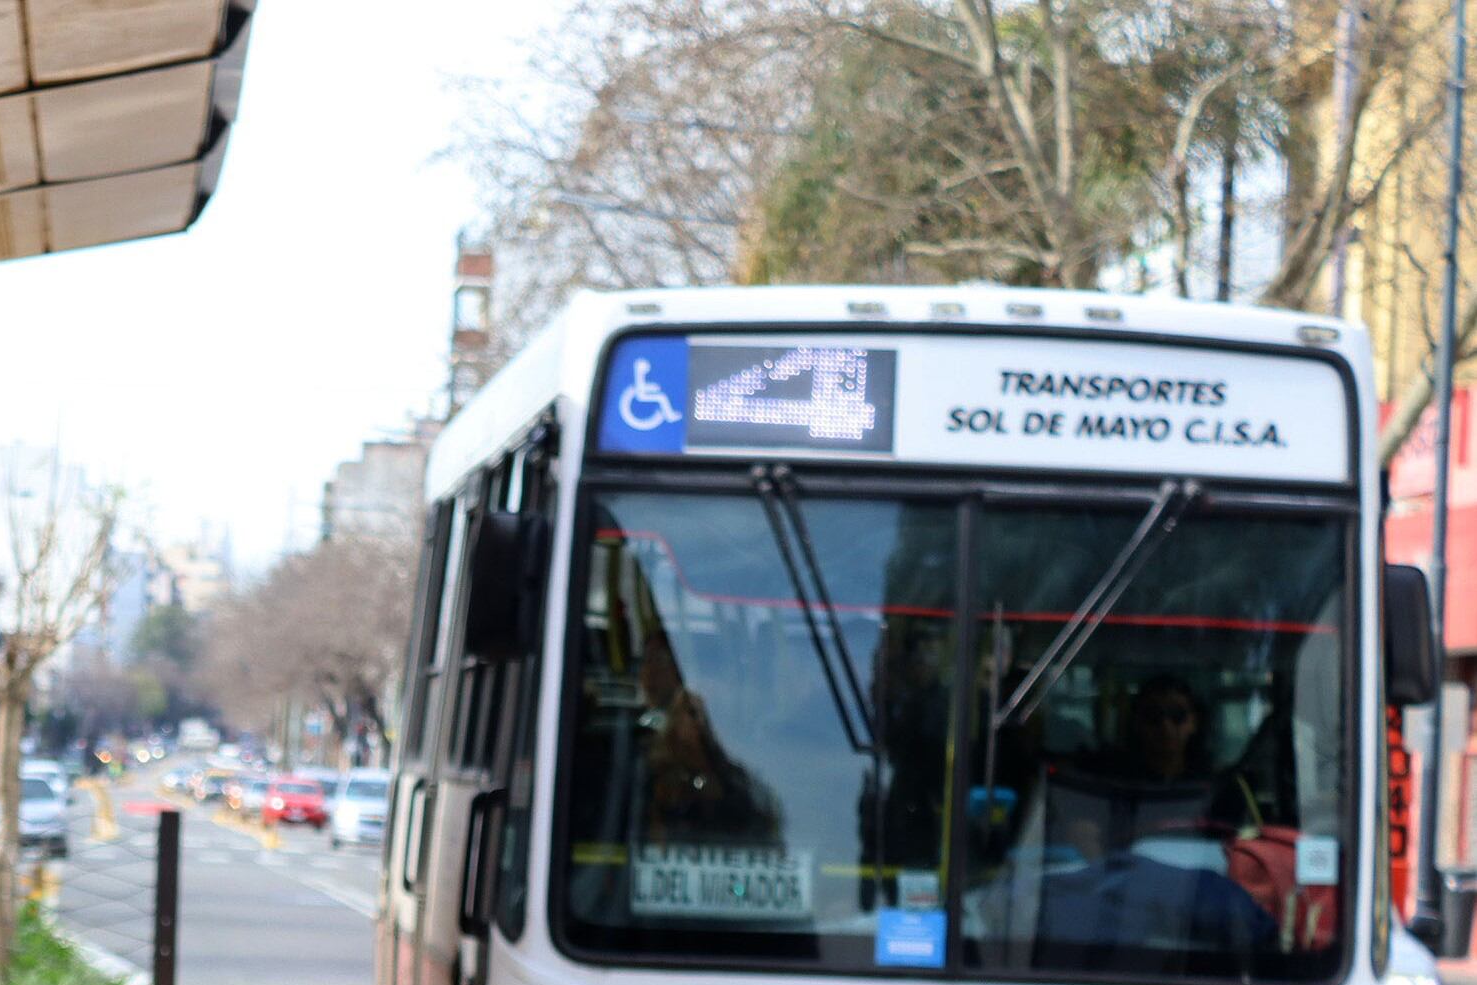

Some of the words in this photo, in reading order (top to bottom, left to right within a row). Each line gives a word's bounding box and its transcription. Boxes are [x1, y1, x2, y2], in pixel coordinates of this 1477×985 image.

[999, 370, 1227, 406] TRANSPORTES
[946, 408, 1008, 434] SOL
[1023, 411, 1064, 436] DE
[1077, 415, 1171, 441] MAYO
[1184, 419, 1288, 447] C.I.S.A.
